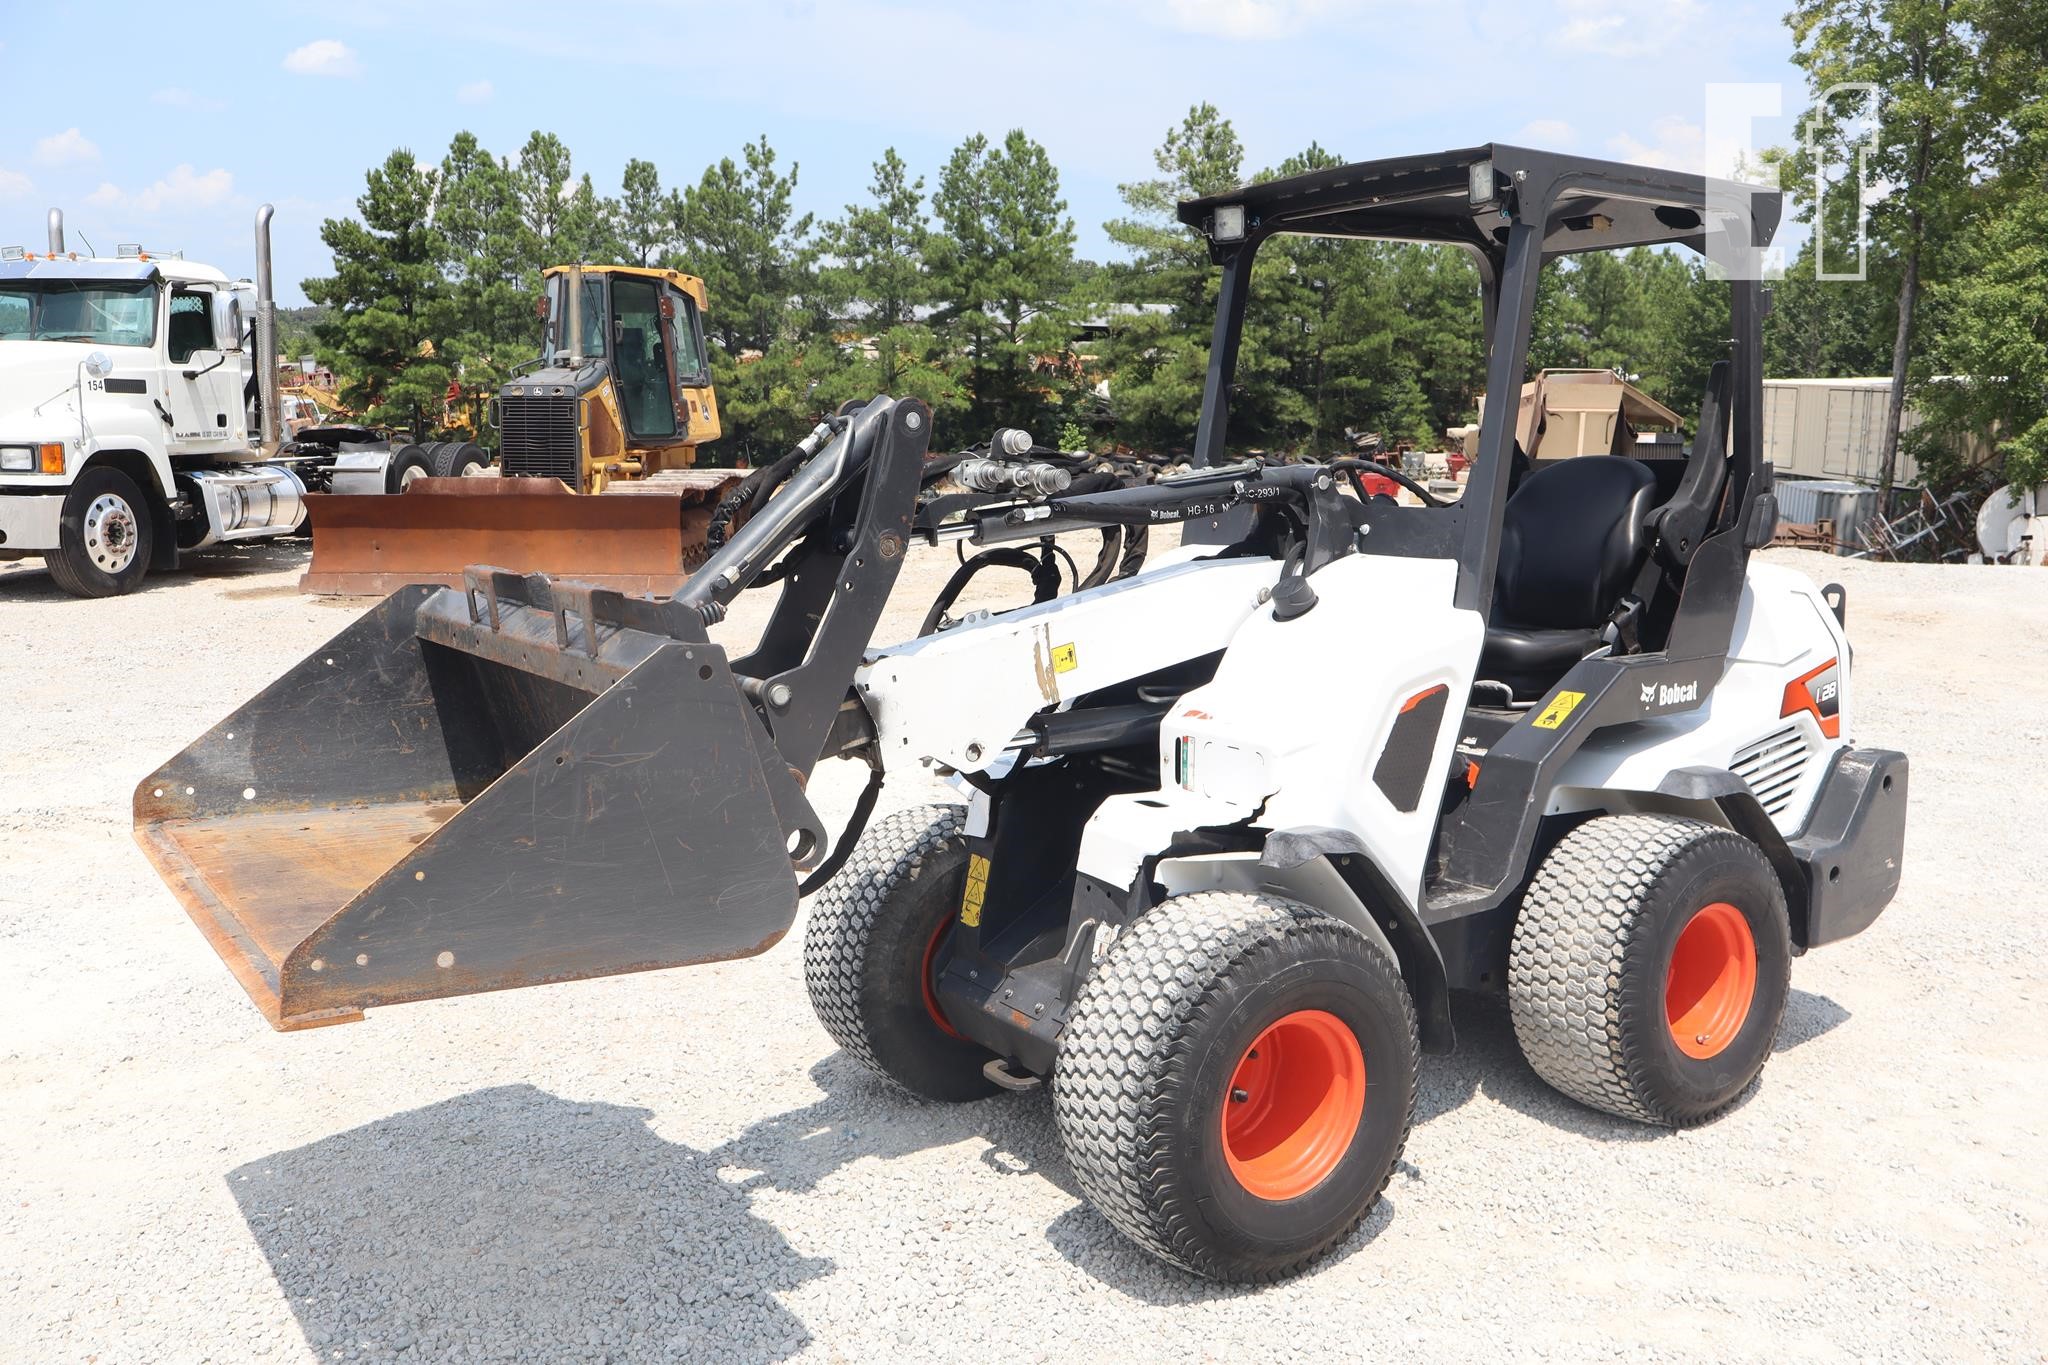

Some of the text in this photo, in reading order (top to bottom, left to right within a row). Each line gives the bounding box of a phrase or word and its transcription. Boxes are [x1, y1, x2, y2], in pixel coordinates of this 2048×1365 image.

[88, 380, 103, 391] 154
[1187, 504, 1215, 516] HG-16
[1659, 680, 1697, 706] Bobcat
